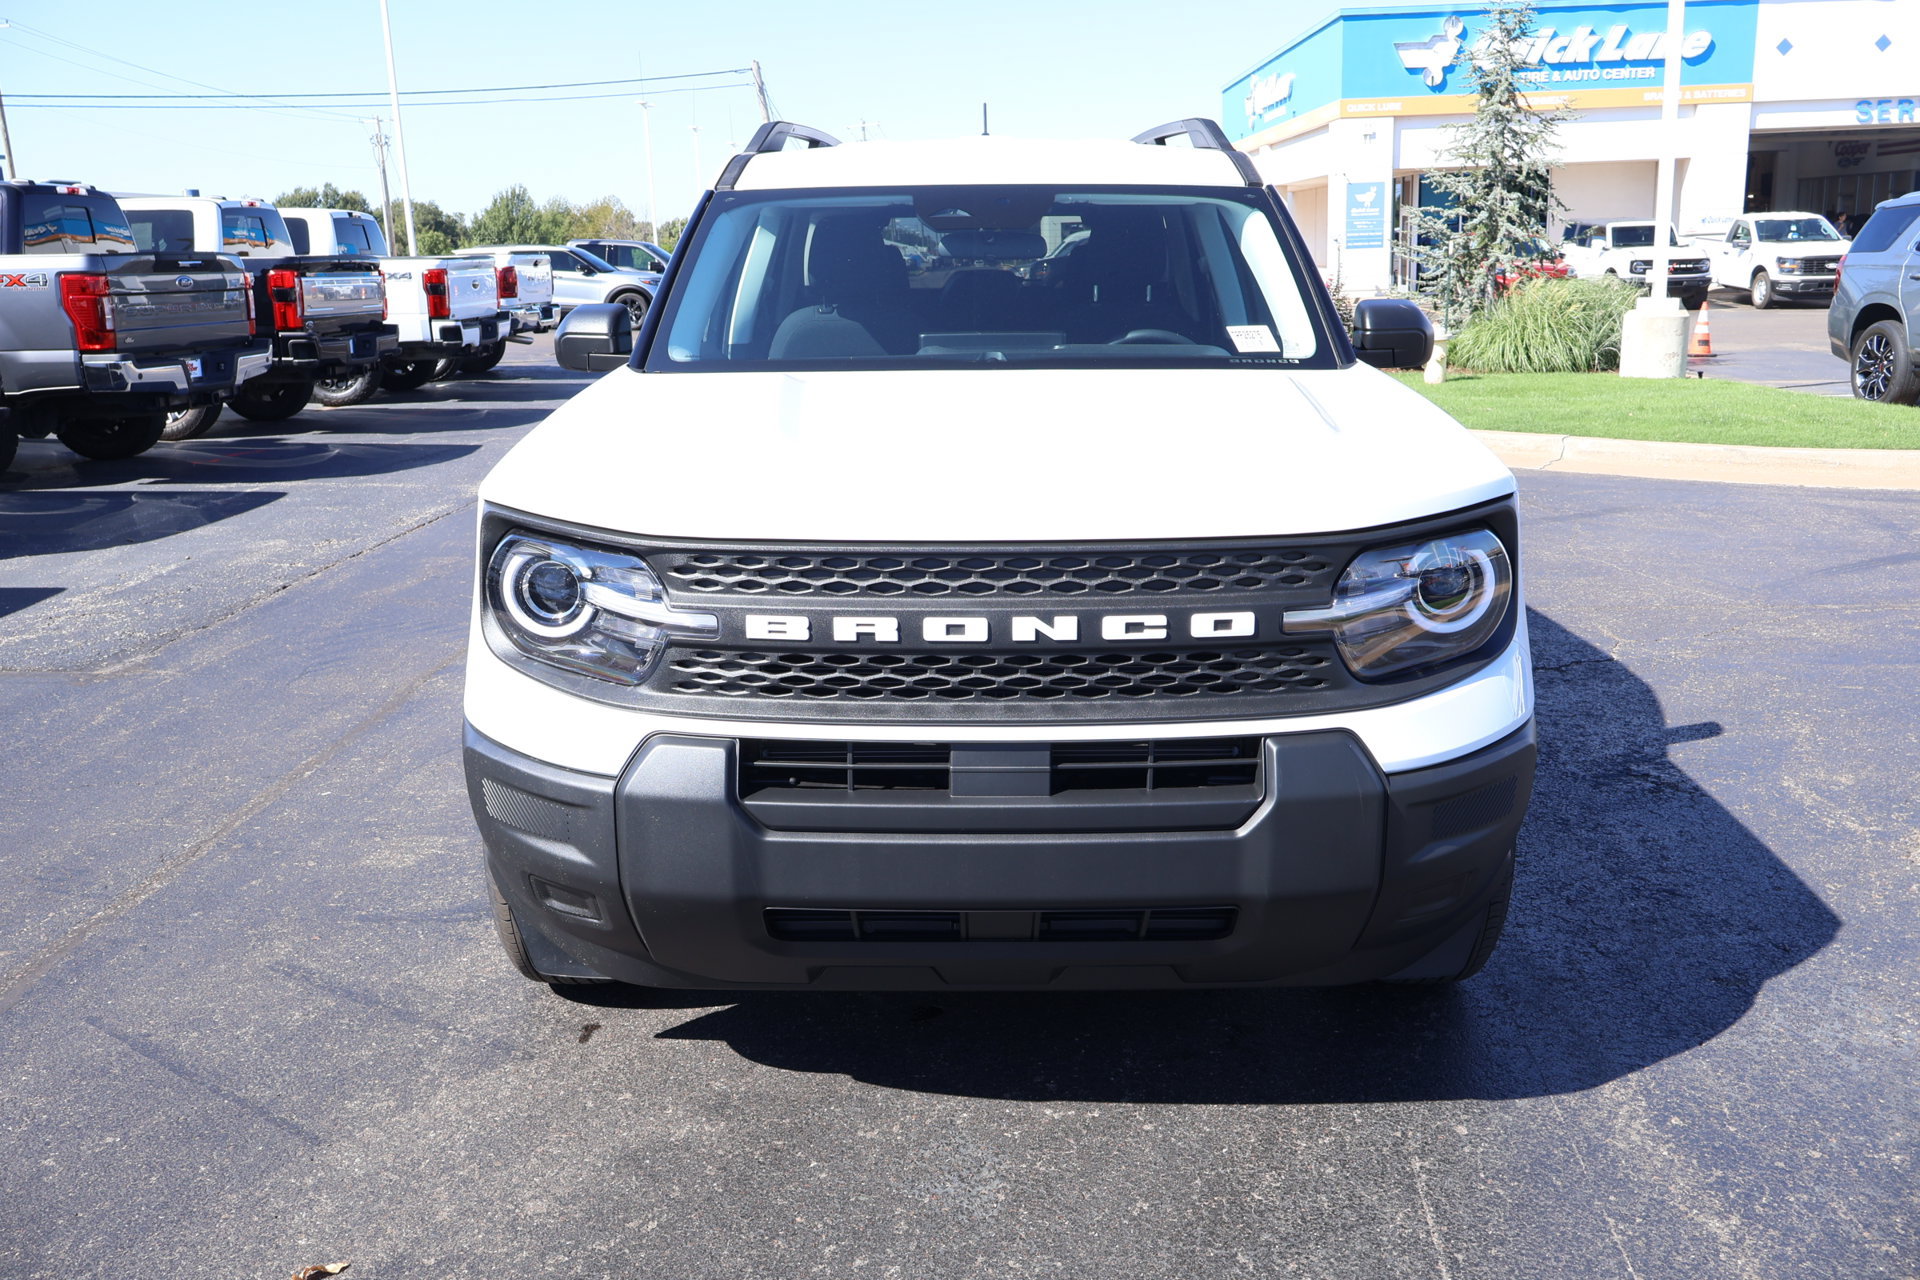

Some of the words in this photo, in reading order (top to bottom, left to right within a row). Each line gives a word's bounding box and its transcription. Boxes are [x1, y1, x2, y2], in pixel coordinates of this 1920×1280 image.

[1552, 72, 1562, 82] &
[1563, 69, 1600, 82] AUTO
[1602, 66, 1656, 80] CENTER
[1694, 88, 1747, 99] BATTERIES
[1346, 103, 1376, 113] QUICK
[1855, 99, 1915, 124] SER
[745, 611, 1256, 642] BRONCO
